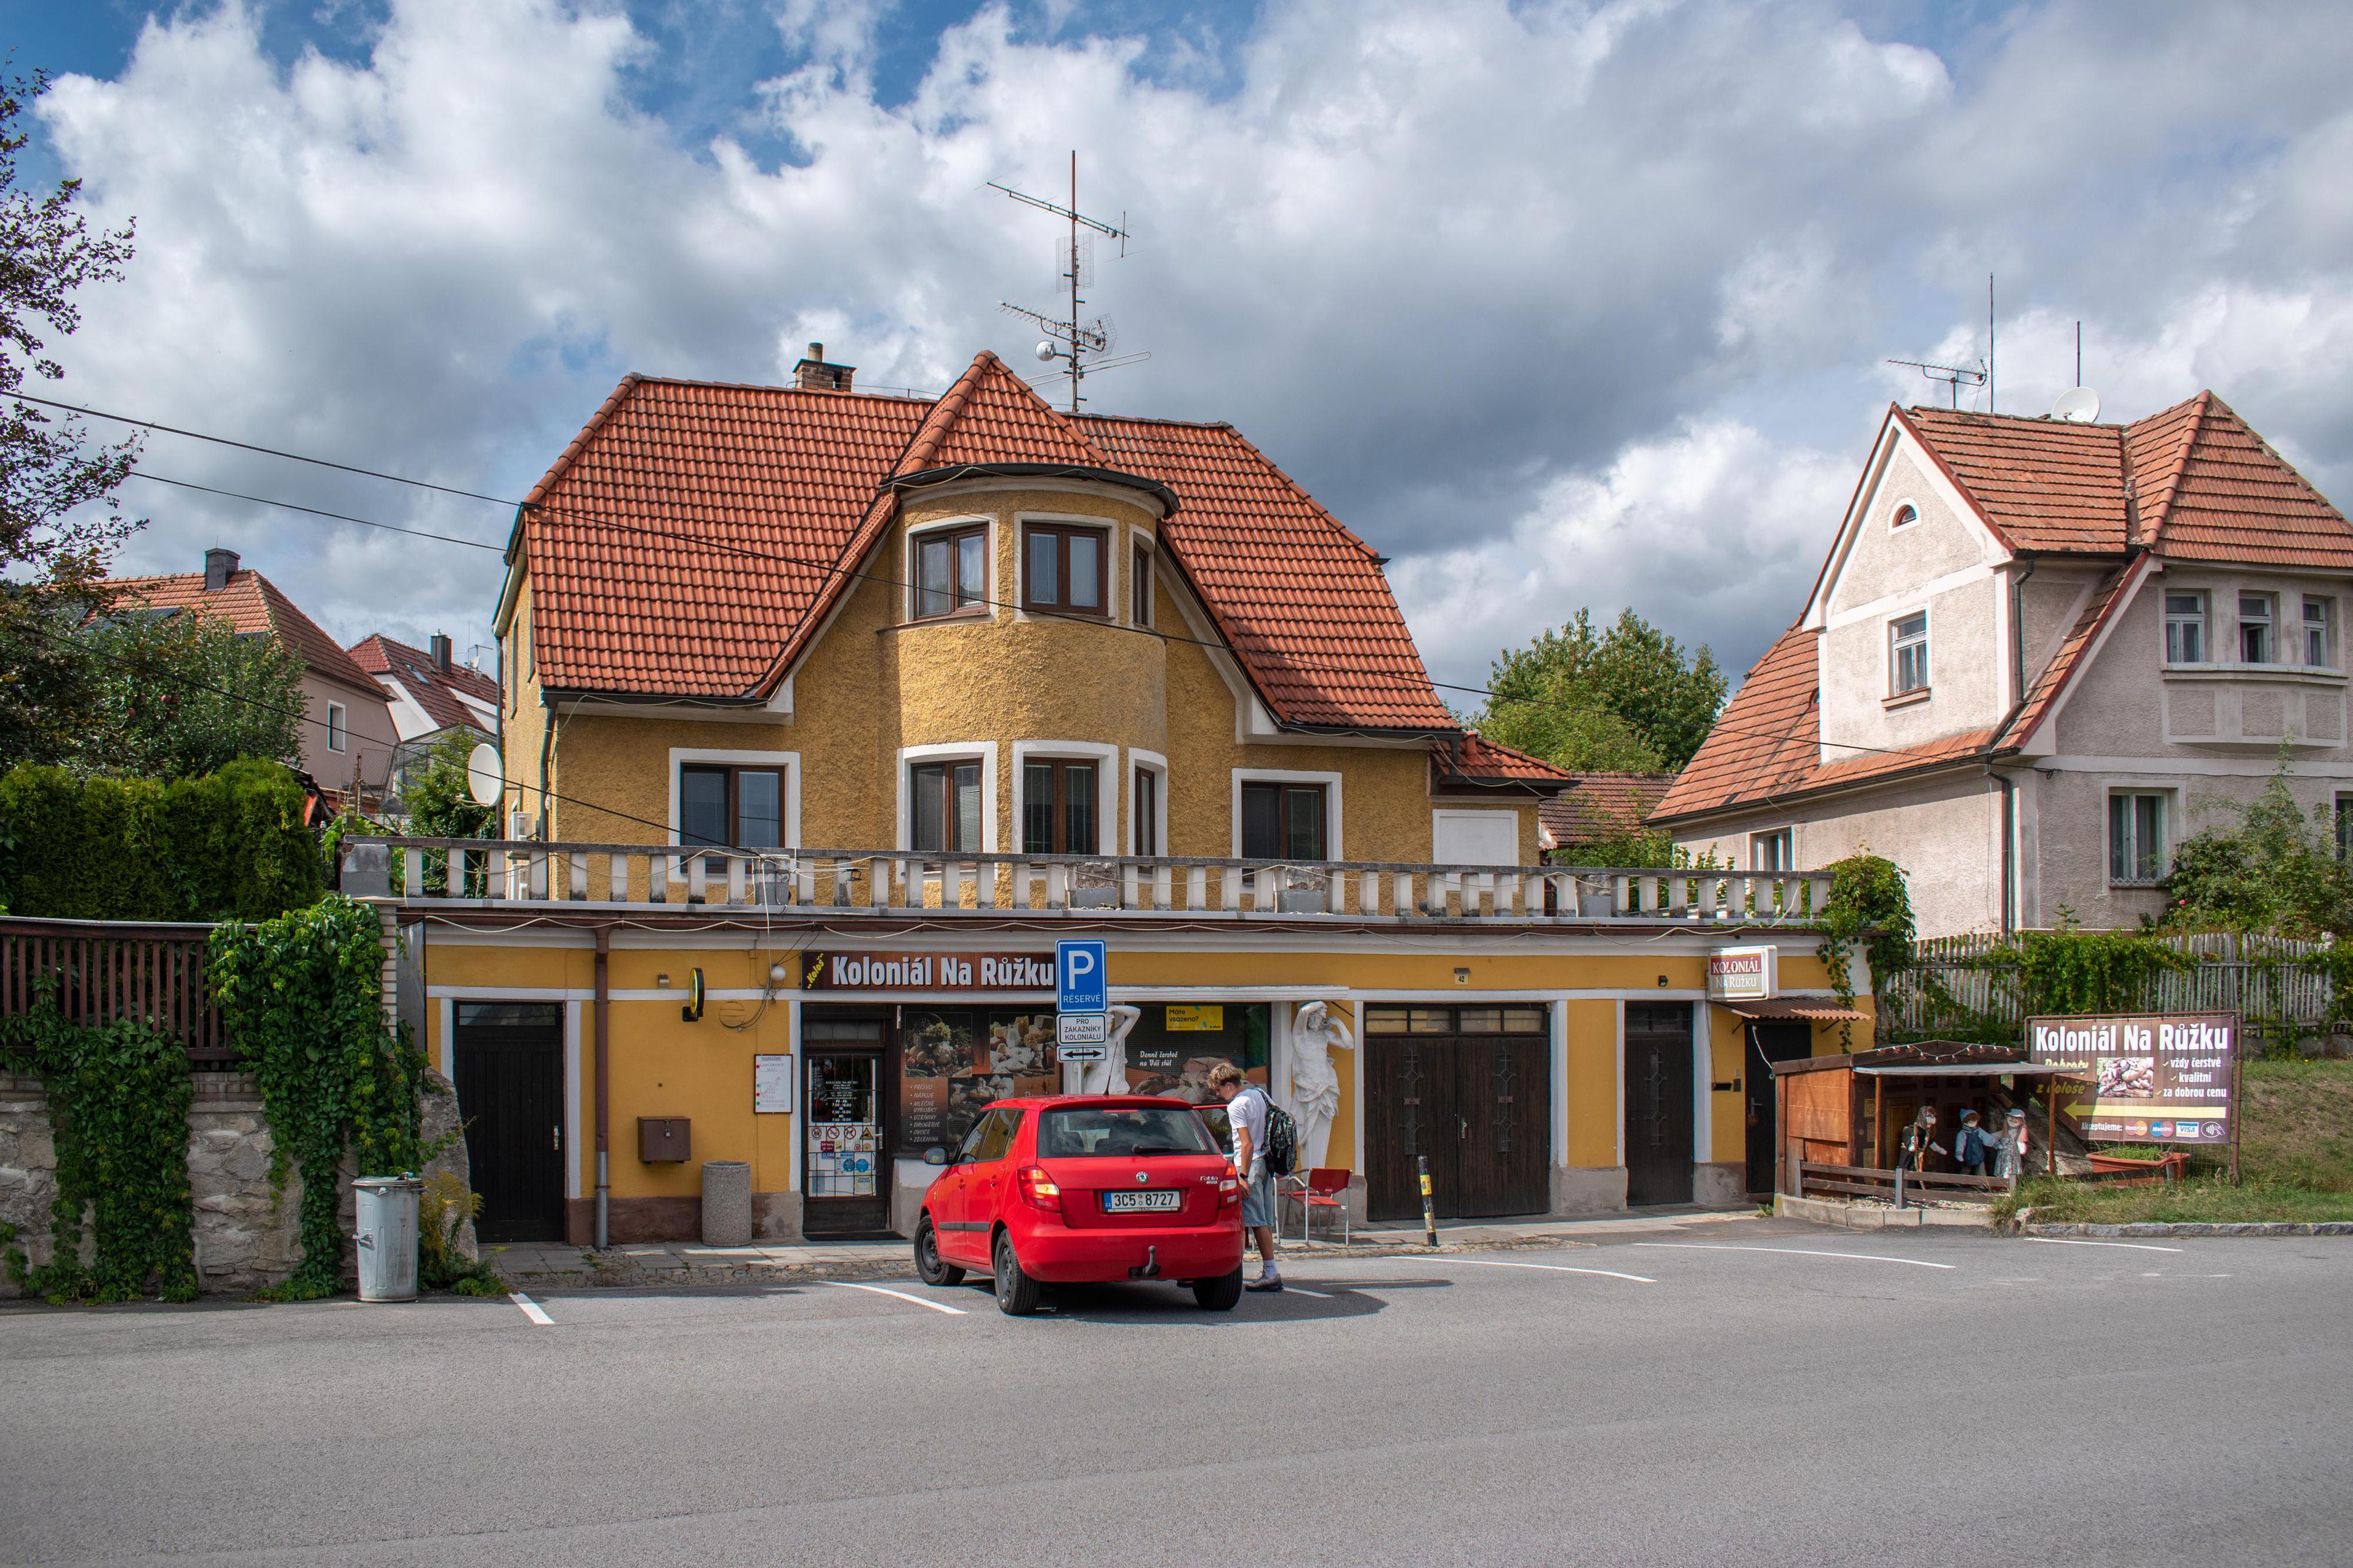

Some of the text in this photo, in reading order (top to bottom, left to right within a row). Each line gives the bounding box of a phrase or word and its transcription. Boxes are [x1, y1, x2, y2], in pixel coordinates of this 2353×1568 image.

[832, 956, 1054, 986] Koloniál Na Růžku
[1068, 950, 1094, 989] P
[1712, 957, 1761, 973] KOLONIÁL
[1715, 976, 1729, 988] NA
[1063, 992, 1101, 1003] RÉSERVÉ
[1065, 1032, 1101, 1040] KOLONIÁLU
[2035, 1023, 2228, 1052] Koloniál Na Růžku
[2170, 1057, 2221, 1069] vždy čerstvé
[2178, 1072, 2212, 1083] kvalitní
[2036, 1084, 2044, 1093] z
[2163, 1087, 2227, 1097] za dobrou cenu
[2081, 1122, 2122, 1132] Akceptujeme:
[1114, 1193, 1174, 1206] 3C5 8727
